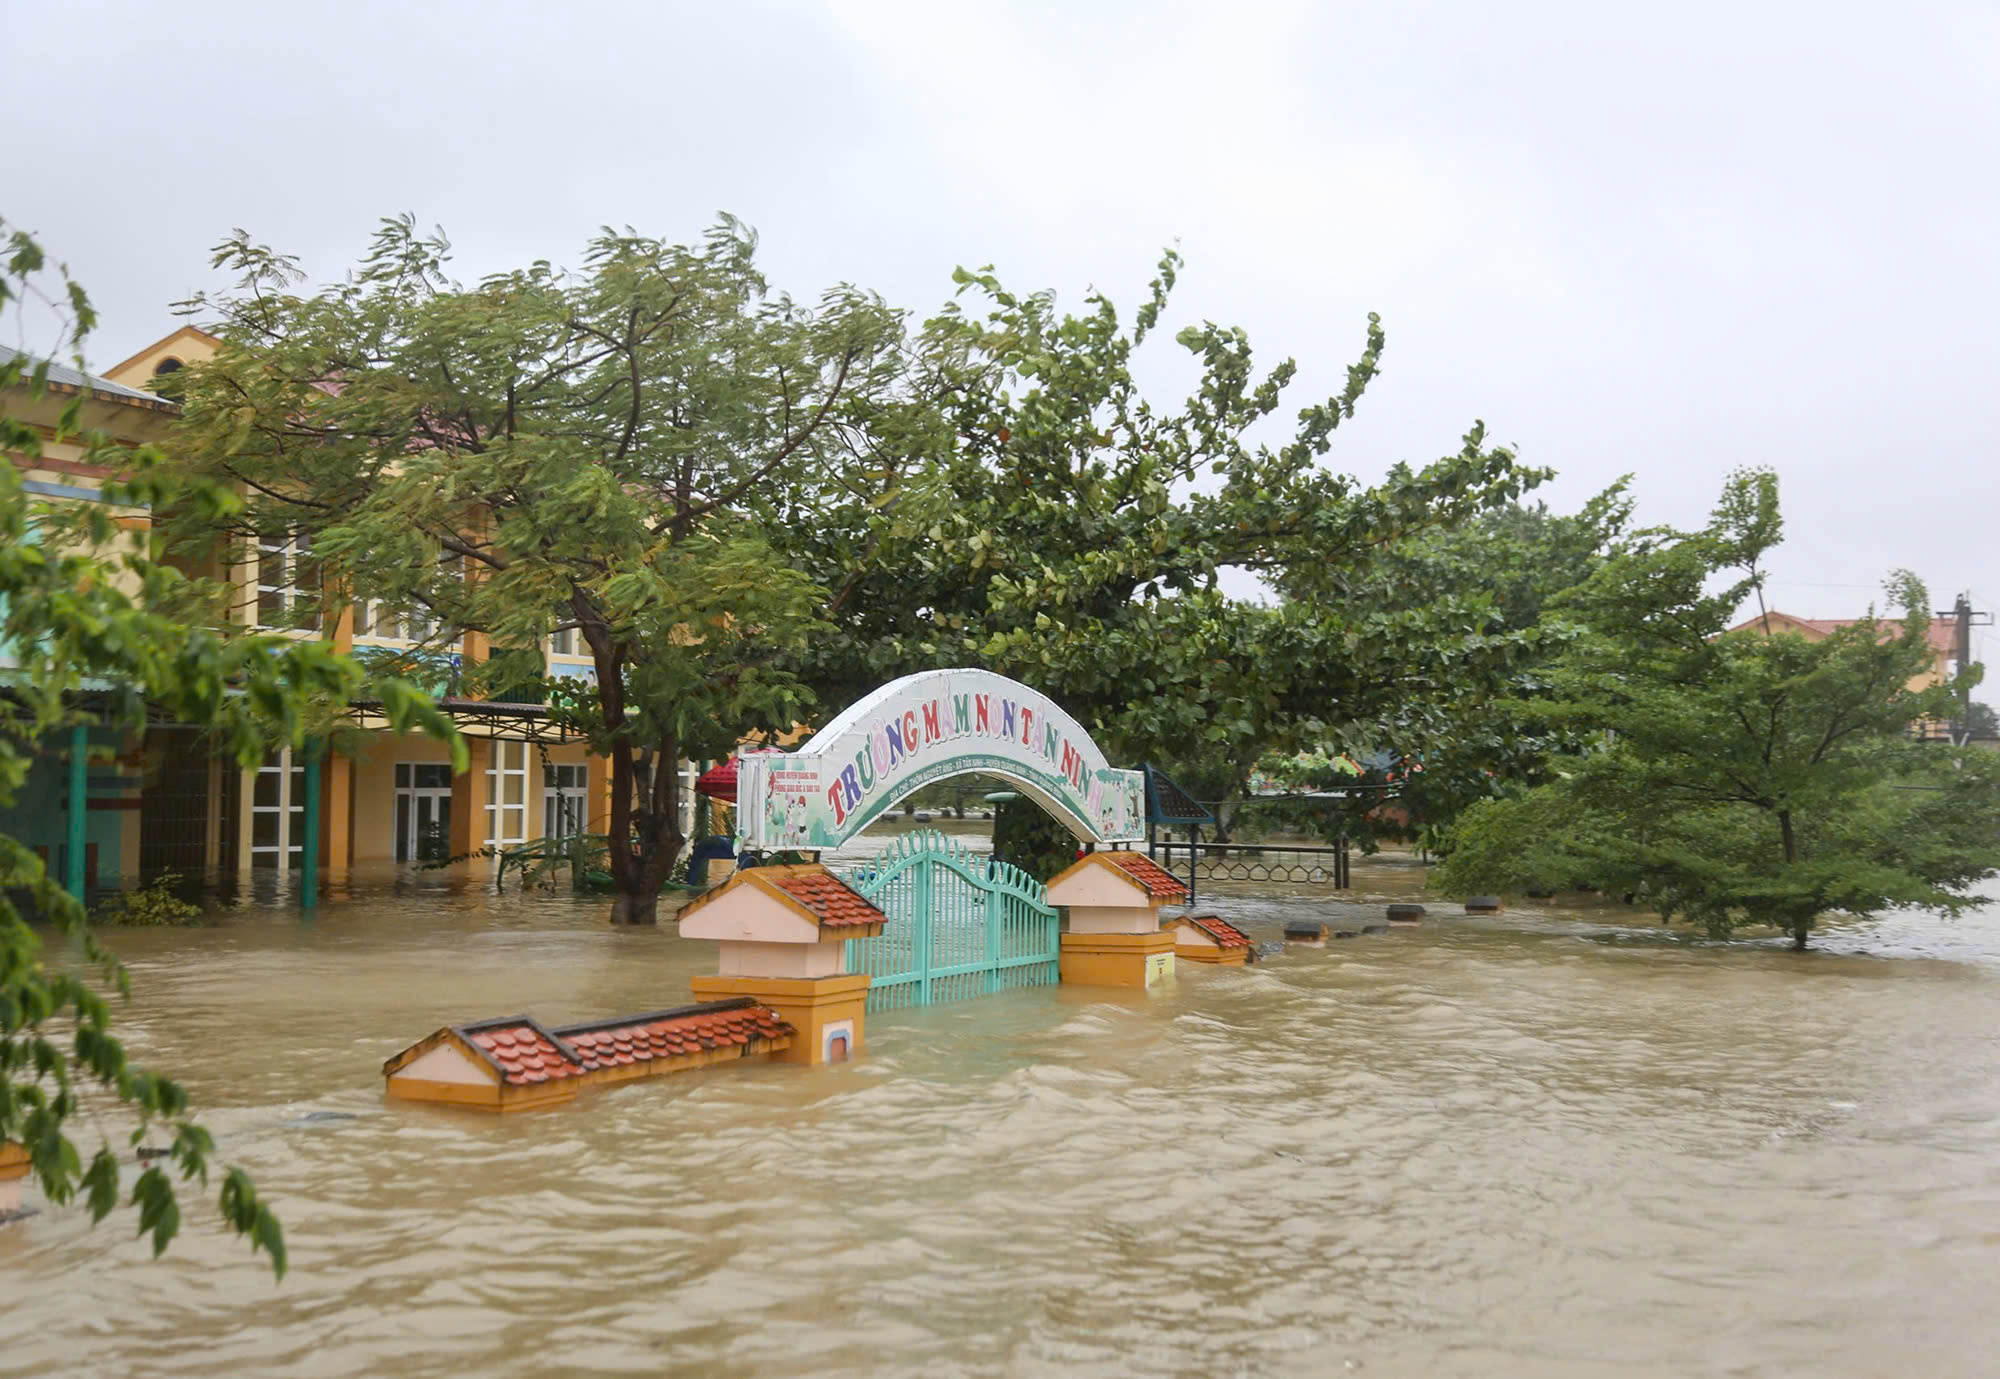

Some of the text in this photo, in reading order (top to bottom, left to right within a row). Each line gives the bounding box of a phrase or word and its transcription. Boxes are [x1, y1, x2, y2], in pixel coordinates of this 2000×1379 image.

[828, 703, 918, 825] TRƯỜNG
[975, 693, 1015, 738] NON
[1021, 701, 1058, 761] TÂN
[1061, 738, 1103, 816] NINH
